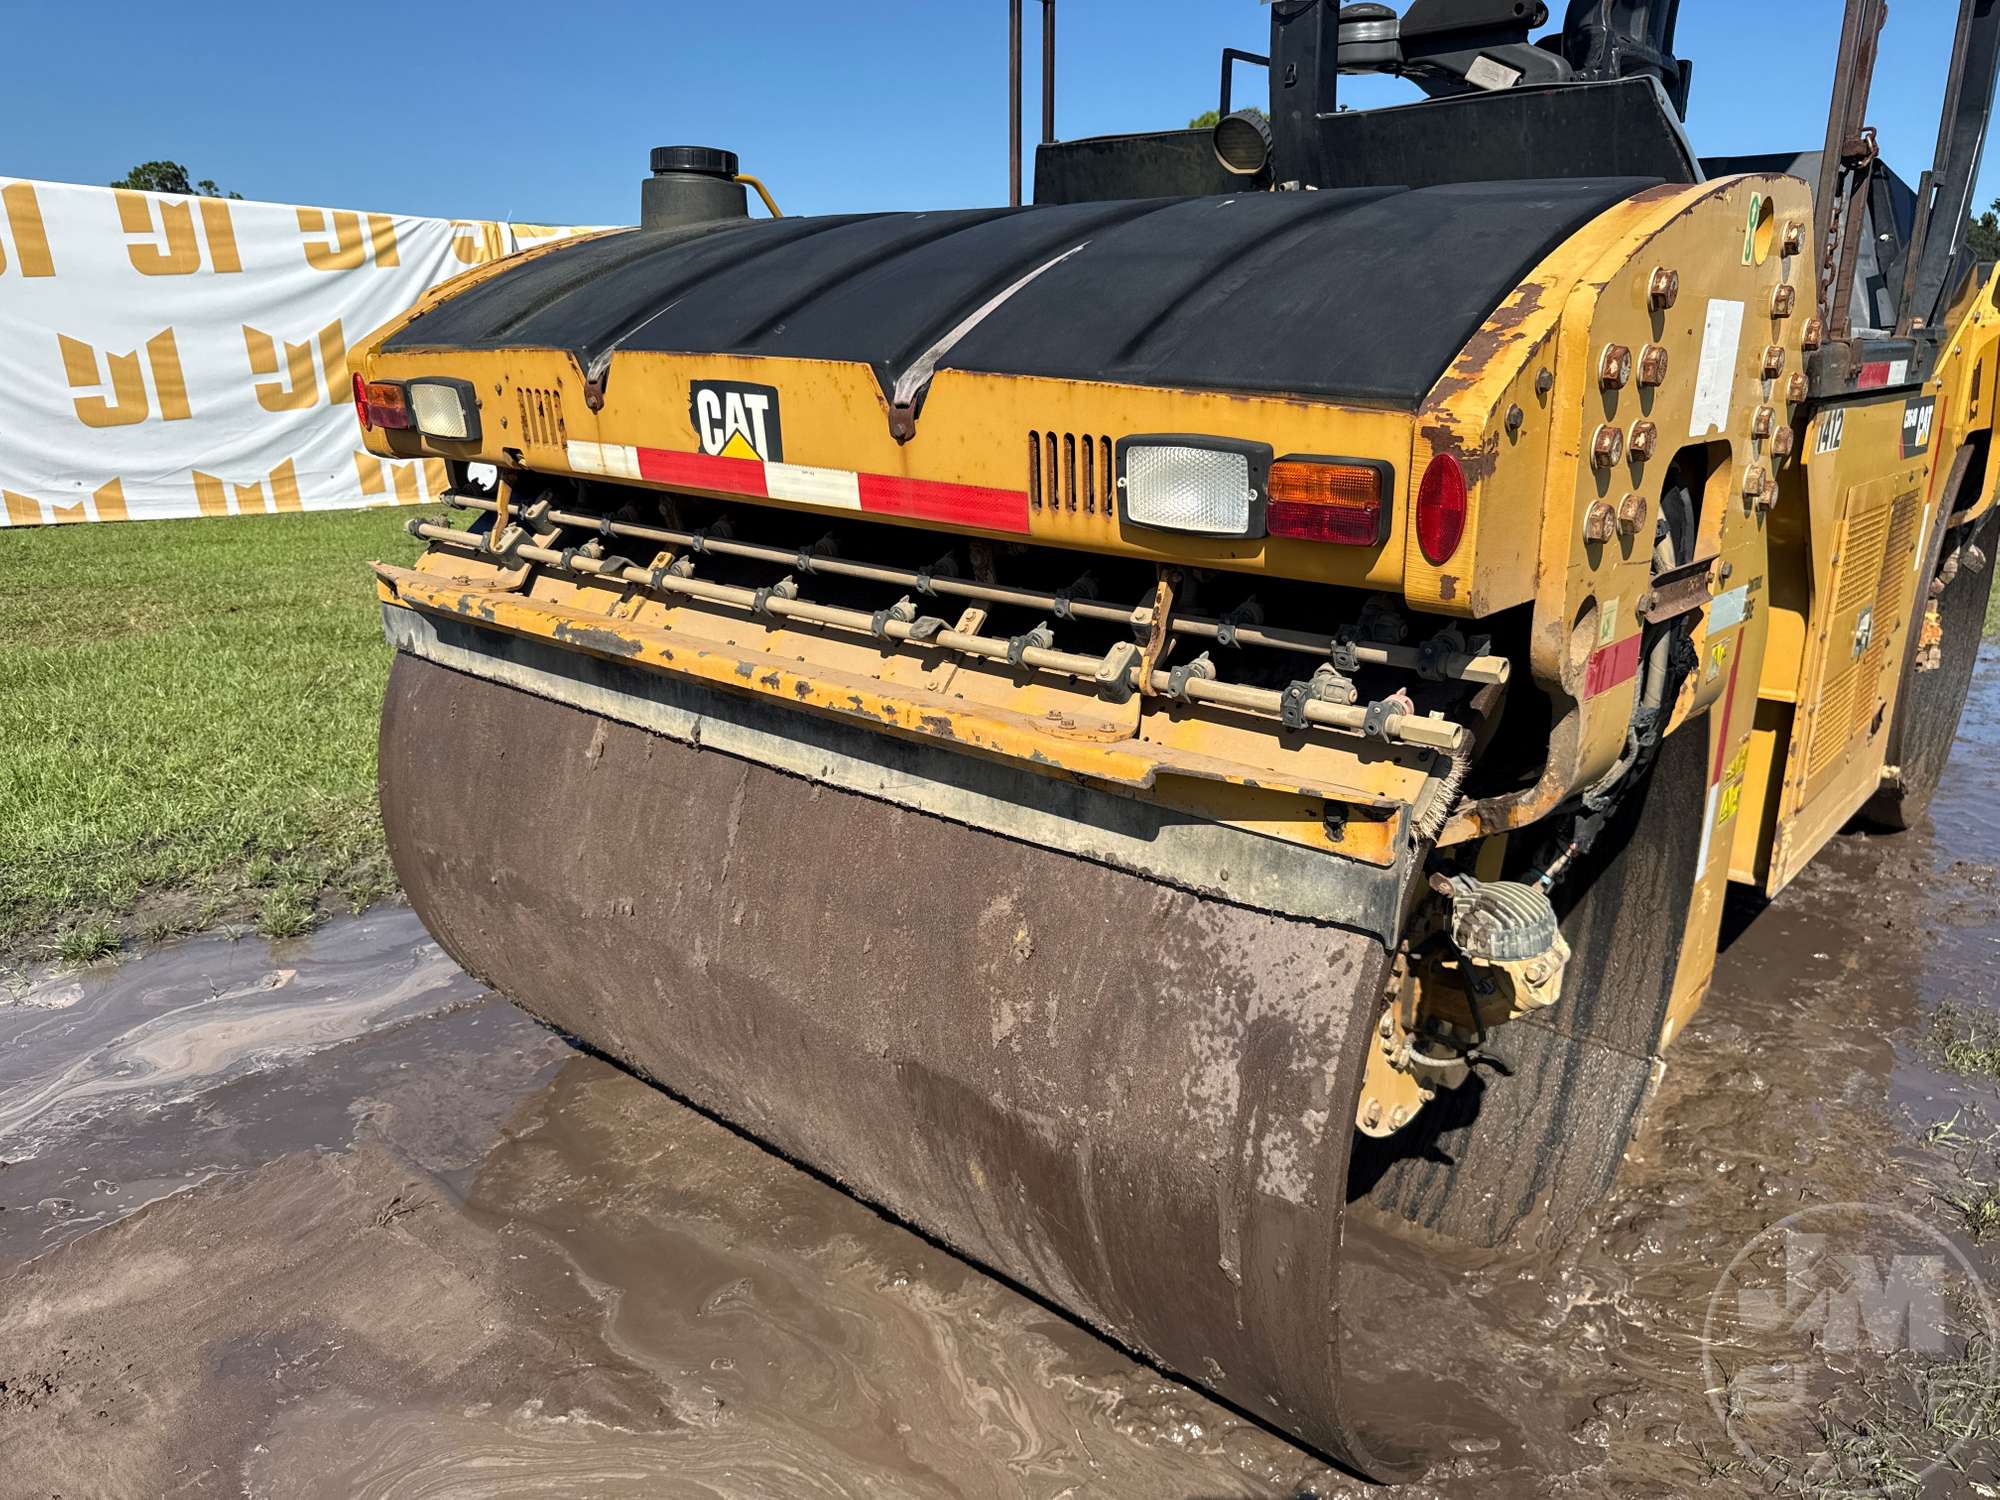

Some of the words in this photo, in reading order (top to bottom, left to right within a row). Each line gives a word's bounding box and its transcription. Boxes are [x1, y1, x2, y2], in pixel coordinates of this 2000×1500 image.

[696, 388, 769, 462] CAT
[1816, 408, 1844, 453] 1412
[1915, 404, 1934, 447] CAT
